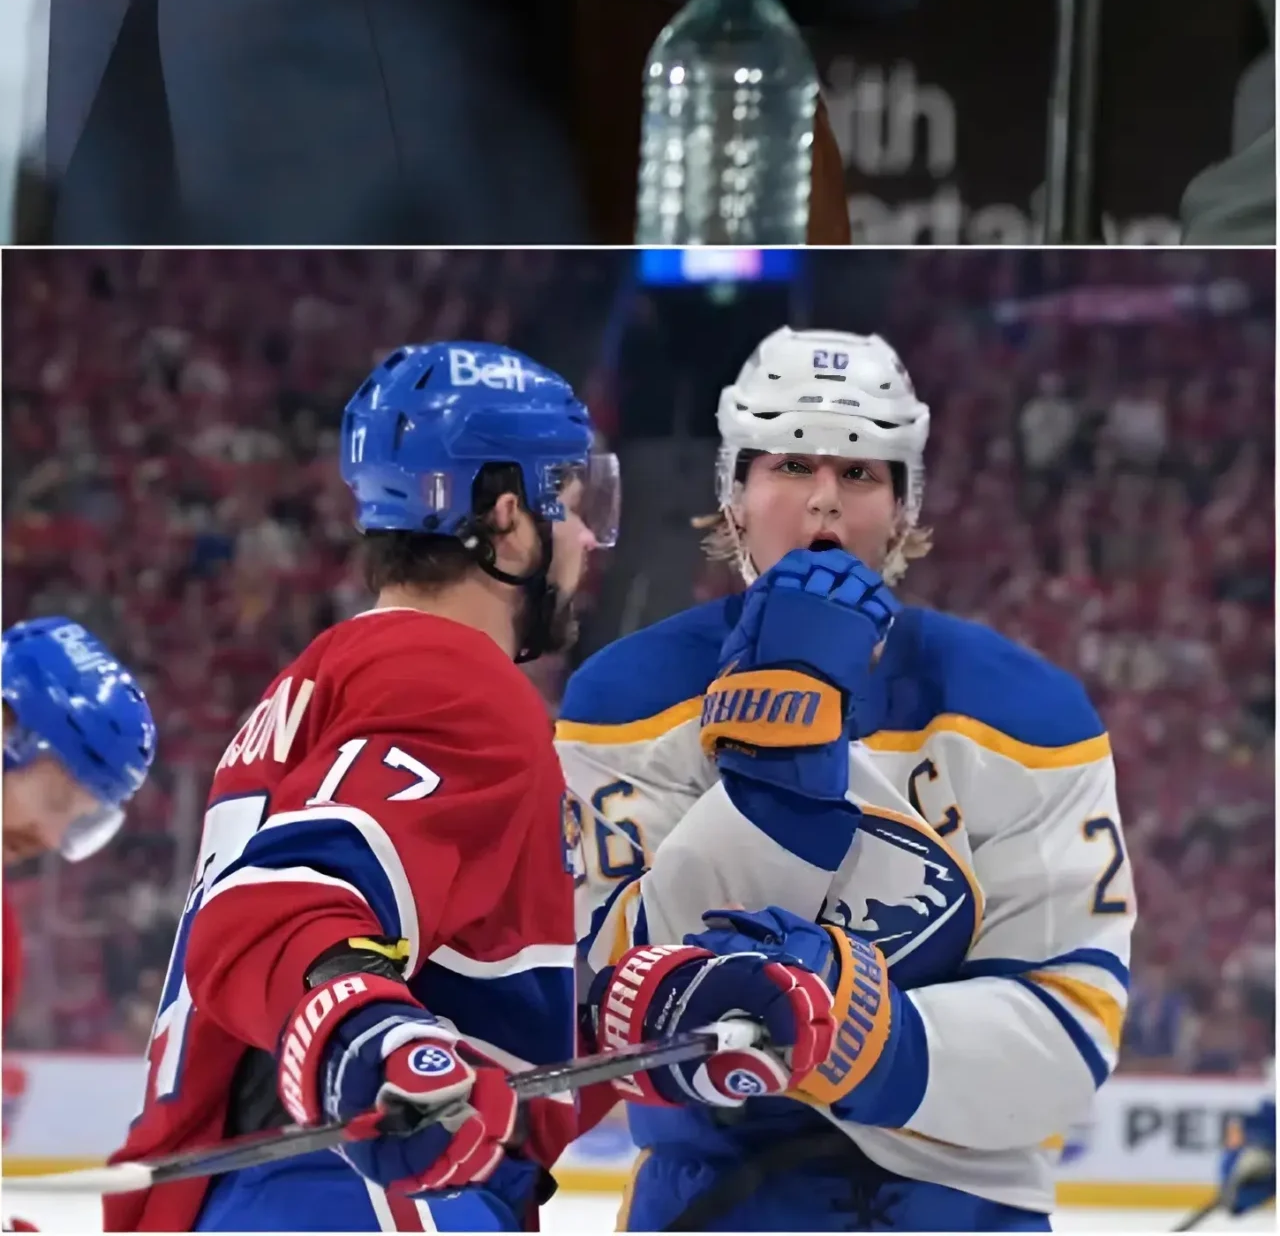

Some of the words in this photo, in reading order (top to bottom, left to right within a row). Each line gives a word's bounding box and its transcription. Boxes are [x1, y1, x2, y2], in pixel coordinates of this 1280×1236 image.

[448, 348, 526, 392] Bell
[305, 738, 442, 806] 17
[907, 758, 961, 838] C
